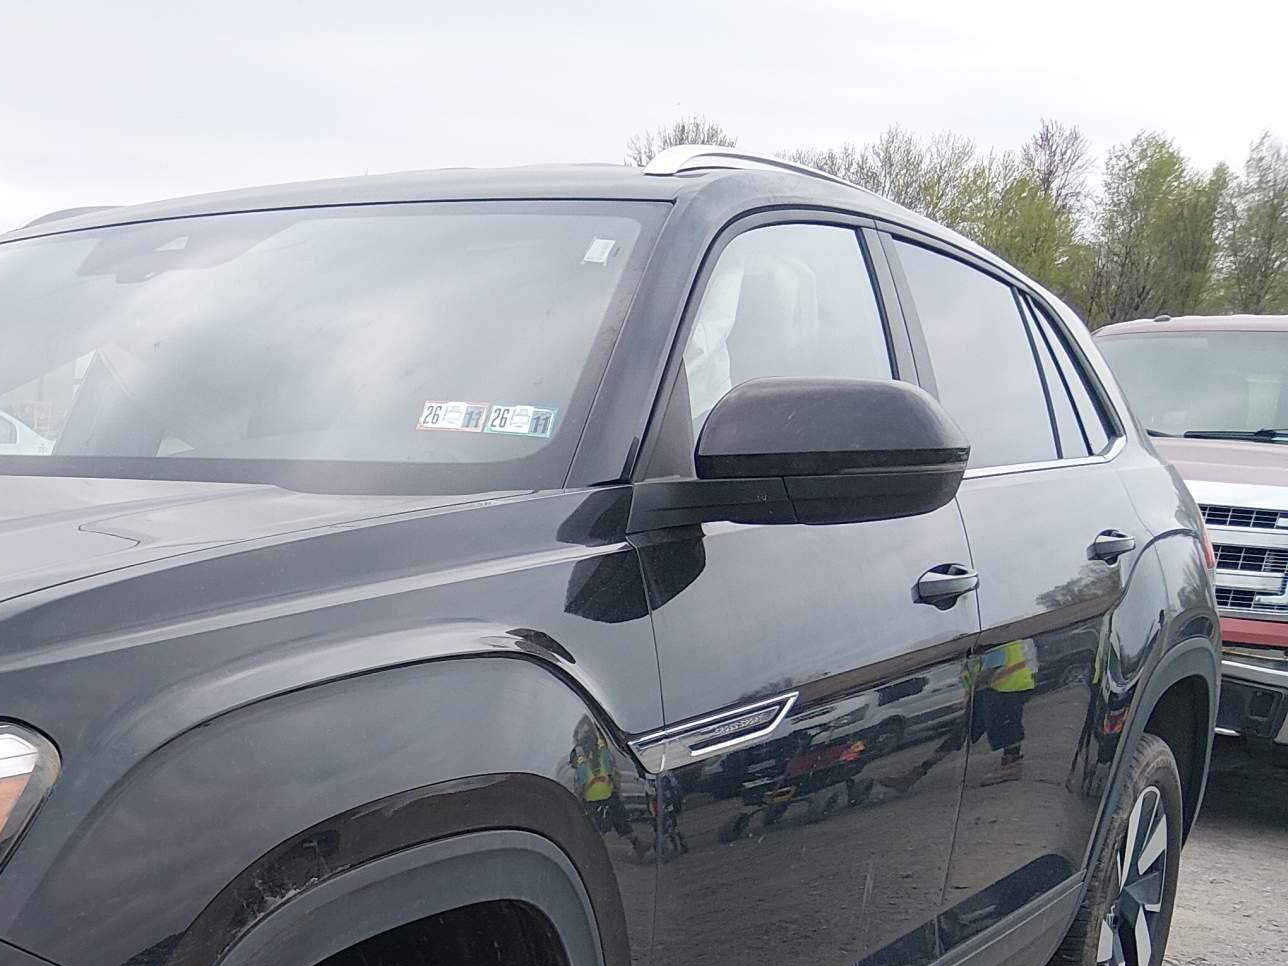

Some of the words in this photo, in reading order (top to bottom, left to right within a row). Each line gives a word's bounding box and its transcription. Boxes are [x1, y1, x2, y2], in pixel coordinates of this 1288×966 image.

[423, 405, 442, 425] 26
[490, 407, 510, 428] 26
[530, 414, 551, 434] 11
